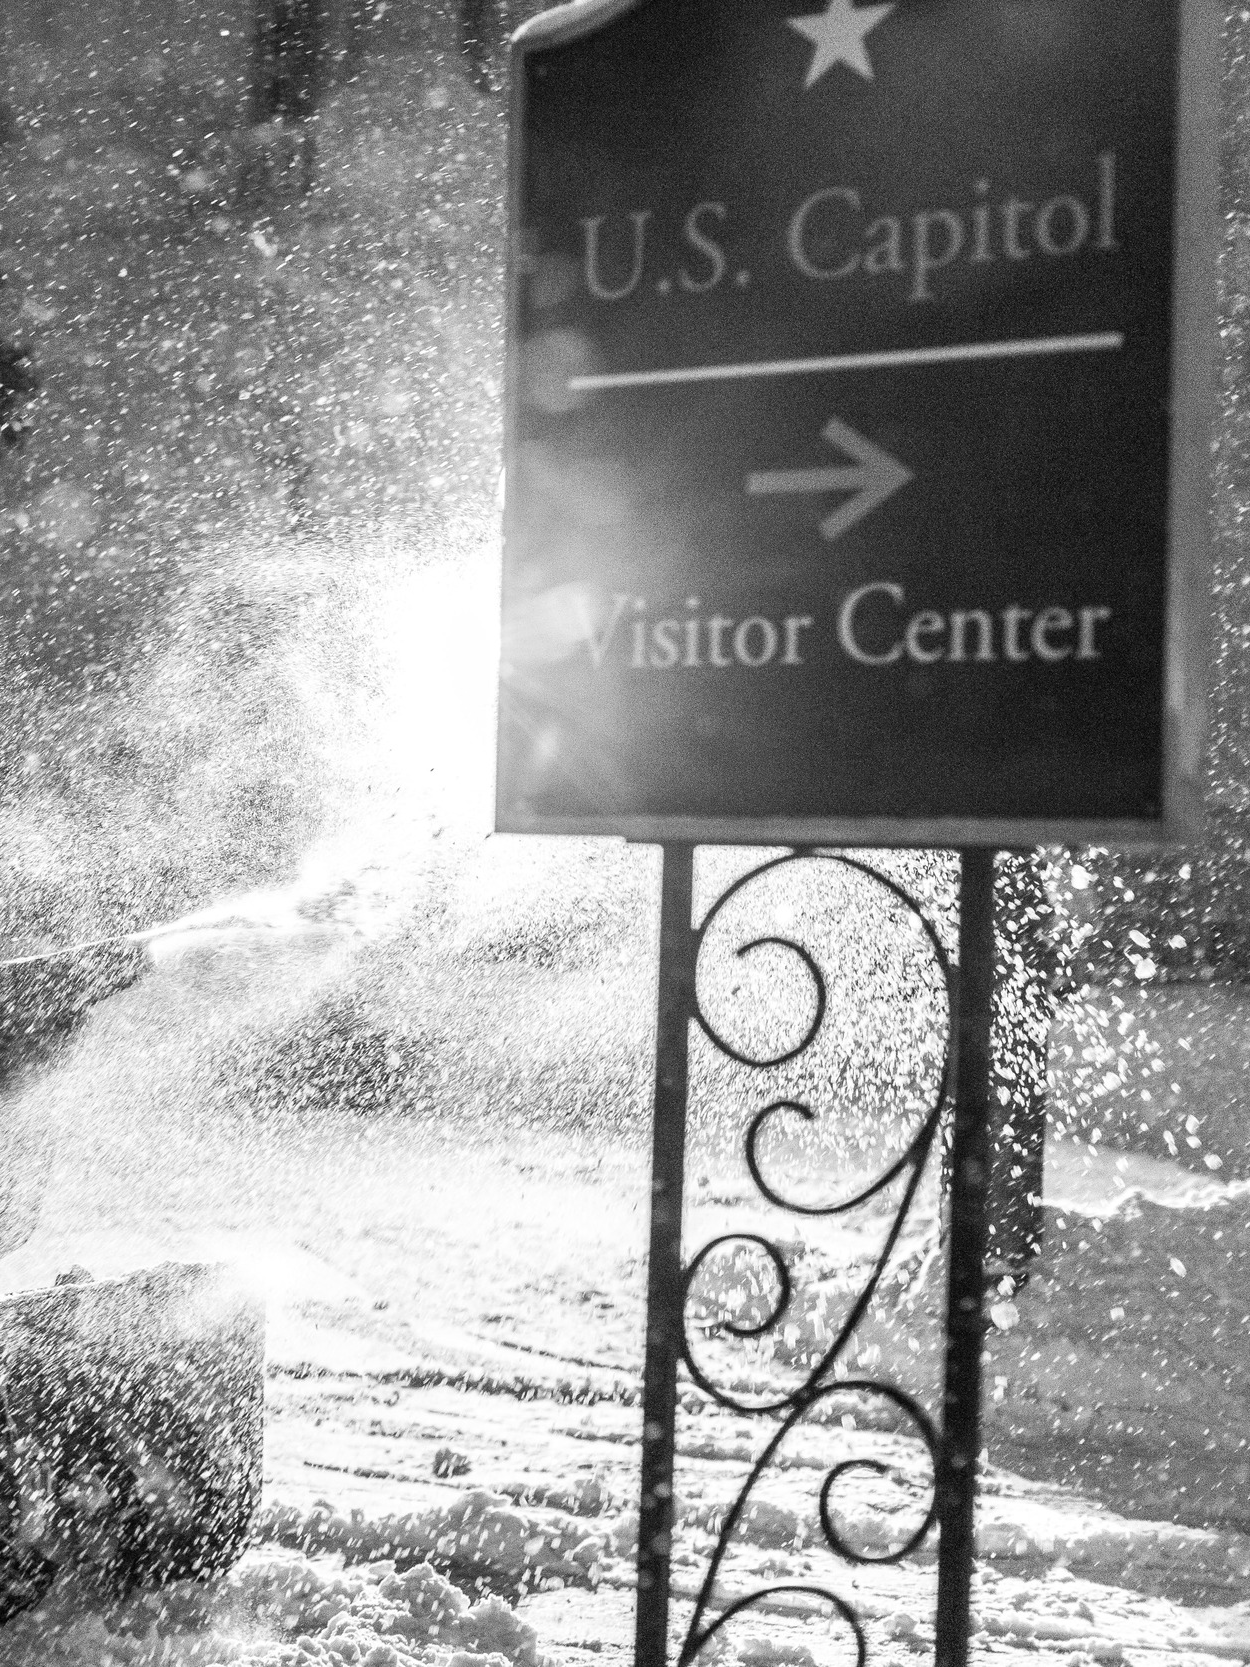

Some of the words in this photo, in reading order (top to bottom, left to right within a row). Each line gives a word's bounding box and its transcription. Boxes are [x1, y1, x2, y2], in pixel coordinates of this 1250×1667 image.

[580, 202, 751, 301] U.S.
[786, 151, 1118, 302] Capitol
[584, 592, 814, 669] Visitor
[836, 581, 1113, 665] Center
